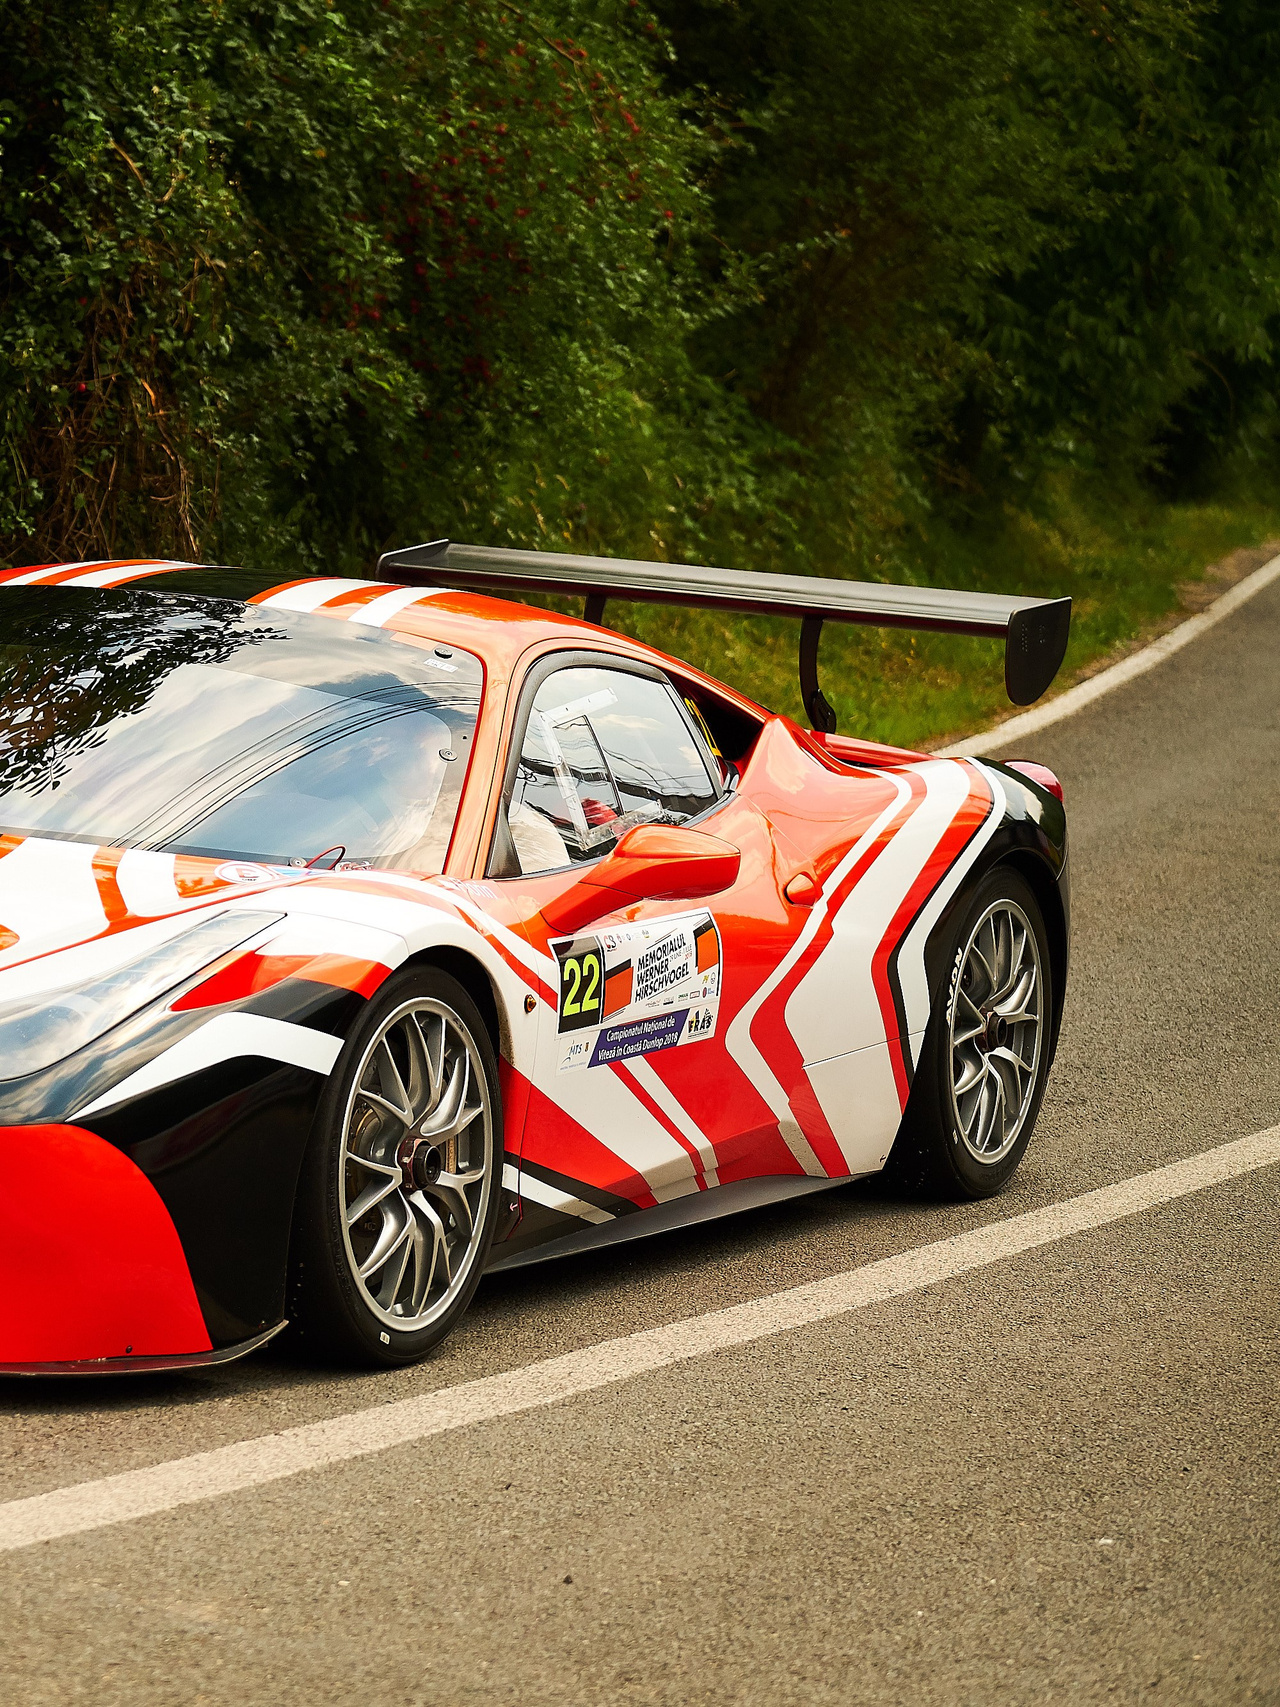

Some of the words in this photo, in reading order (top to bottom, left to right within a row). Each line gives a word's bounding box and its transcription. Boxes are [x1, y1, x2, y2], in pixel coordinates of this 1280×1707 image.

[637, 933, 687, 972] MEMORIALUL
[562, 953, 600, 1017] 22
[634, 962, 690, 1003] HIRSCHVOGEL
[636, 958, 669, 987] WERNER
[945, 947, 963, 1029] AVON
[606, 1024, 644, 1042] Campionatul
[667, 1014, 676, 1028] de
[642, 1034, 664, 1051] Dunlop
[663, 1031, 679, 1047] 2018
